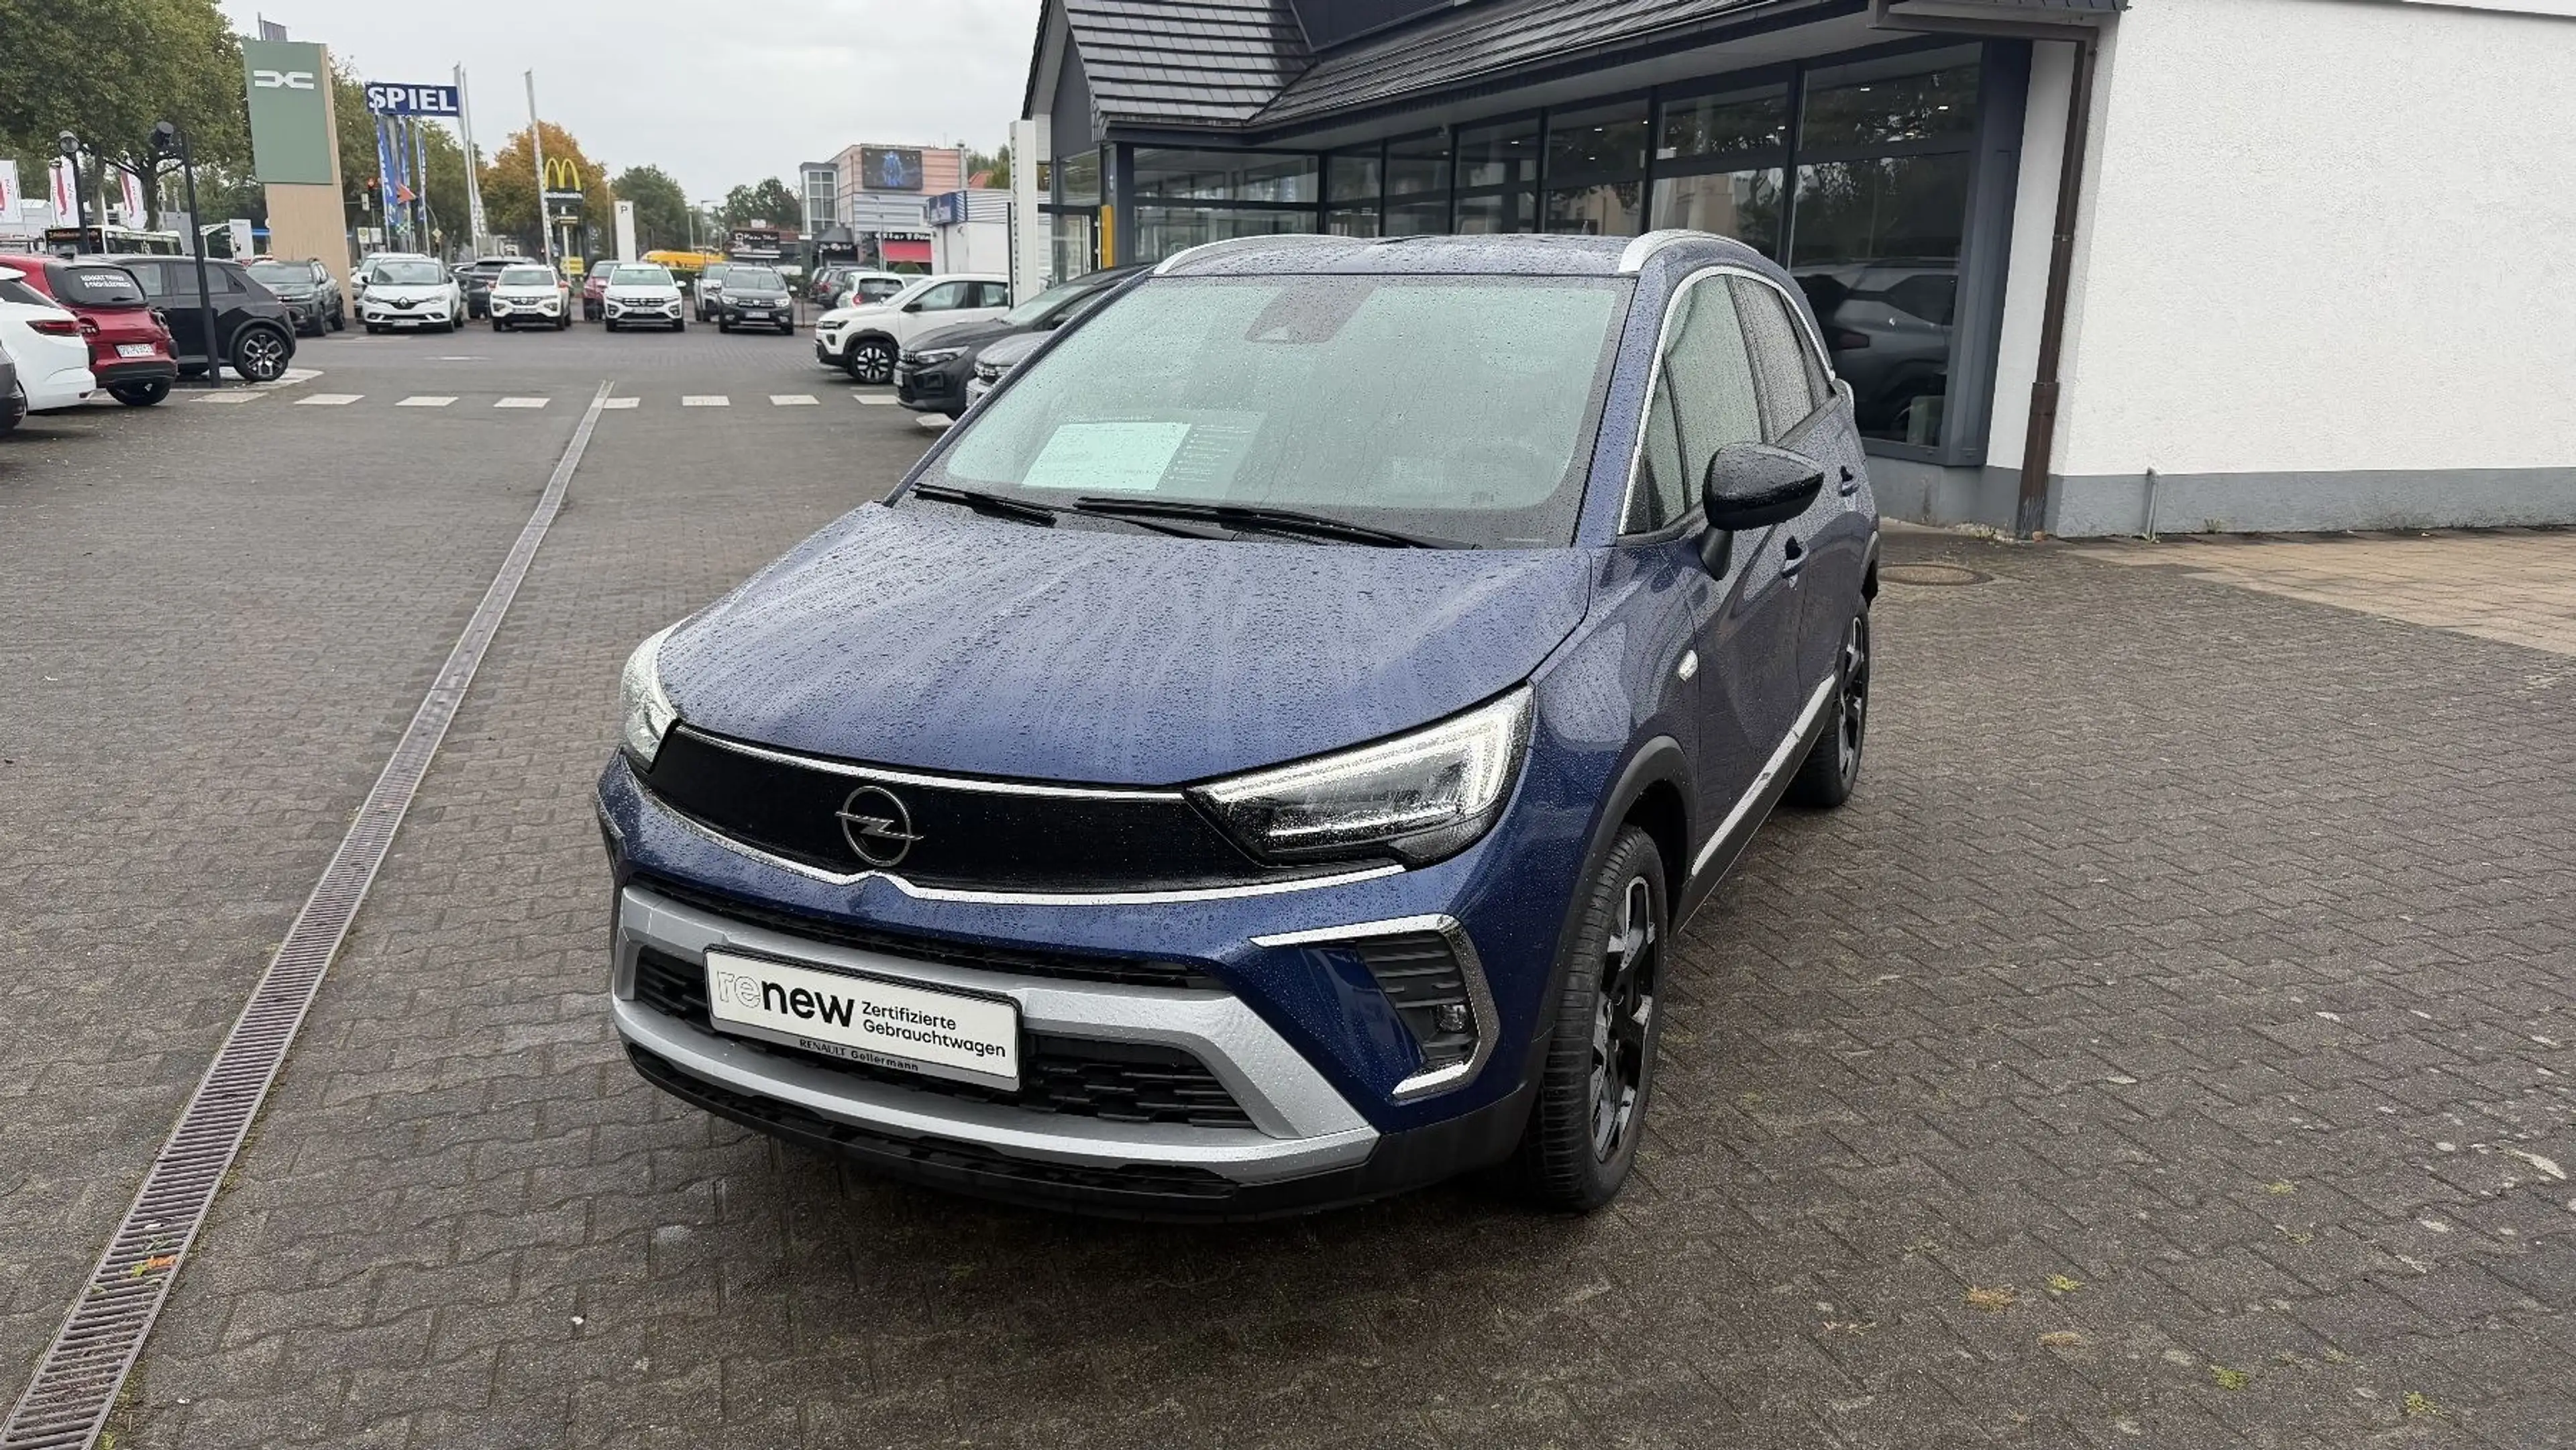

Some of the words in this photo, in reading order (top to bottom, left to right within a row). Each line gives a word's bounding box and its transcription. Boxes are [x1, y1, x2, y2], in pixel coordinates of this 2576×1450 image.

[368, 87, 457, 111] SPIEL
[716, 970, 855, 1028] renew
[861, 1001, 957, 1031] Zertifizierte
[799, 1039, 847, 1057] RENAULT
[863, 1019, 1006, 1058] Gebrauchtwagen
